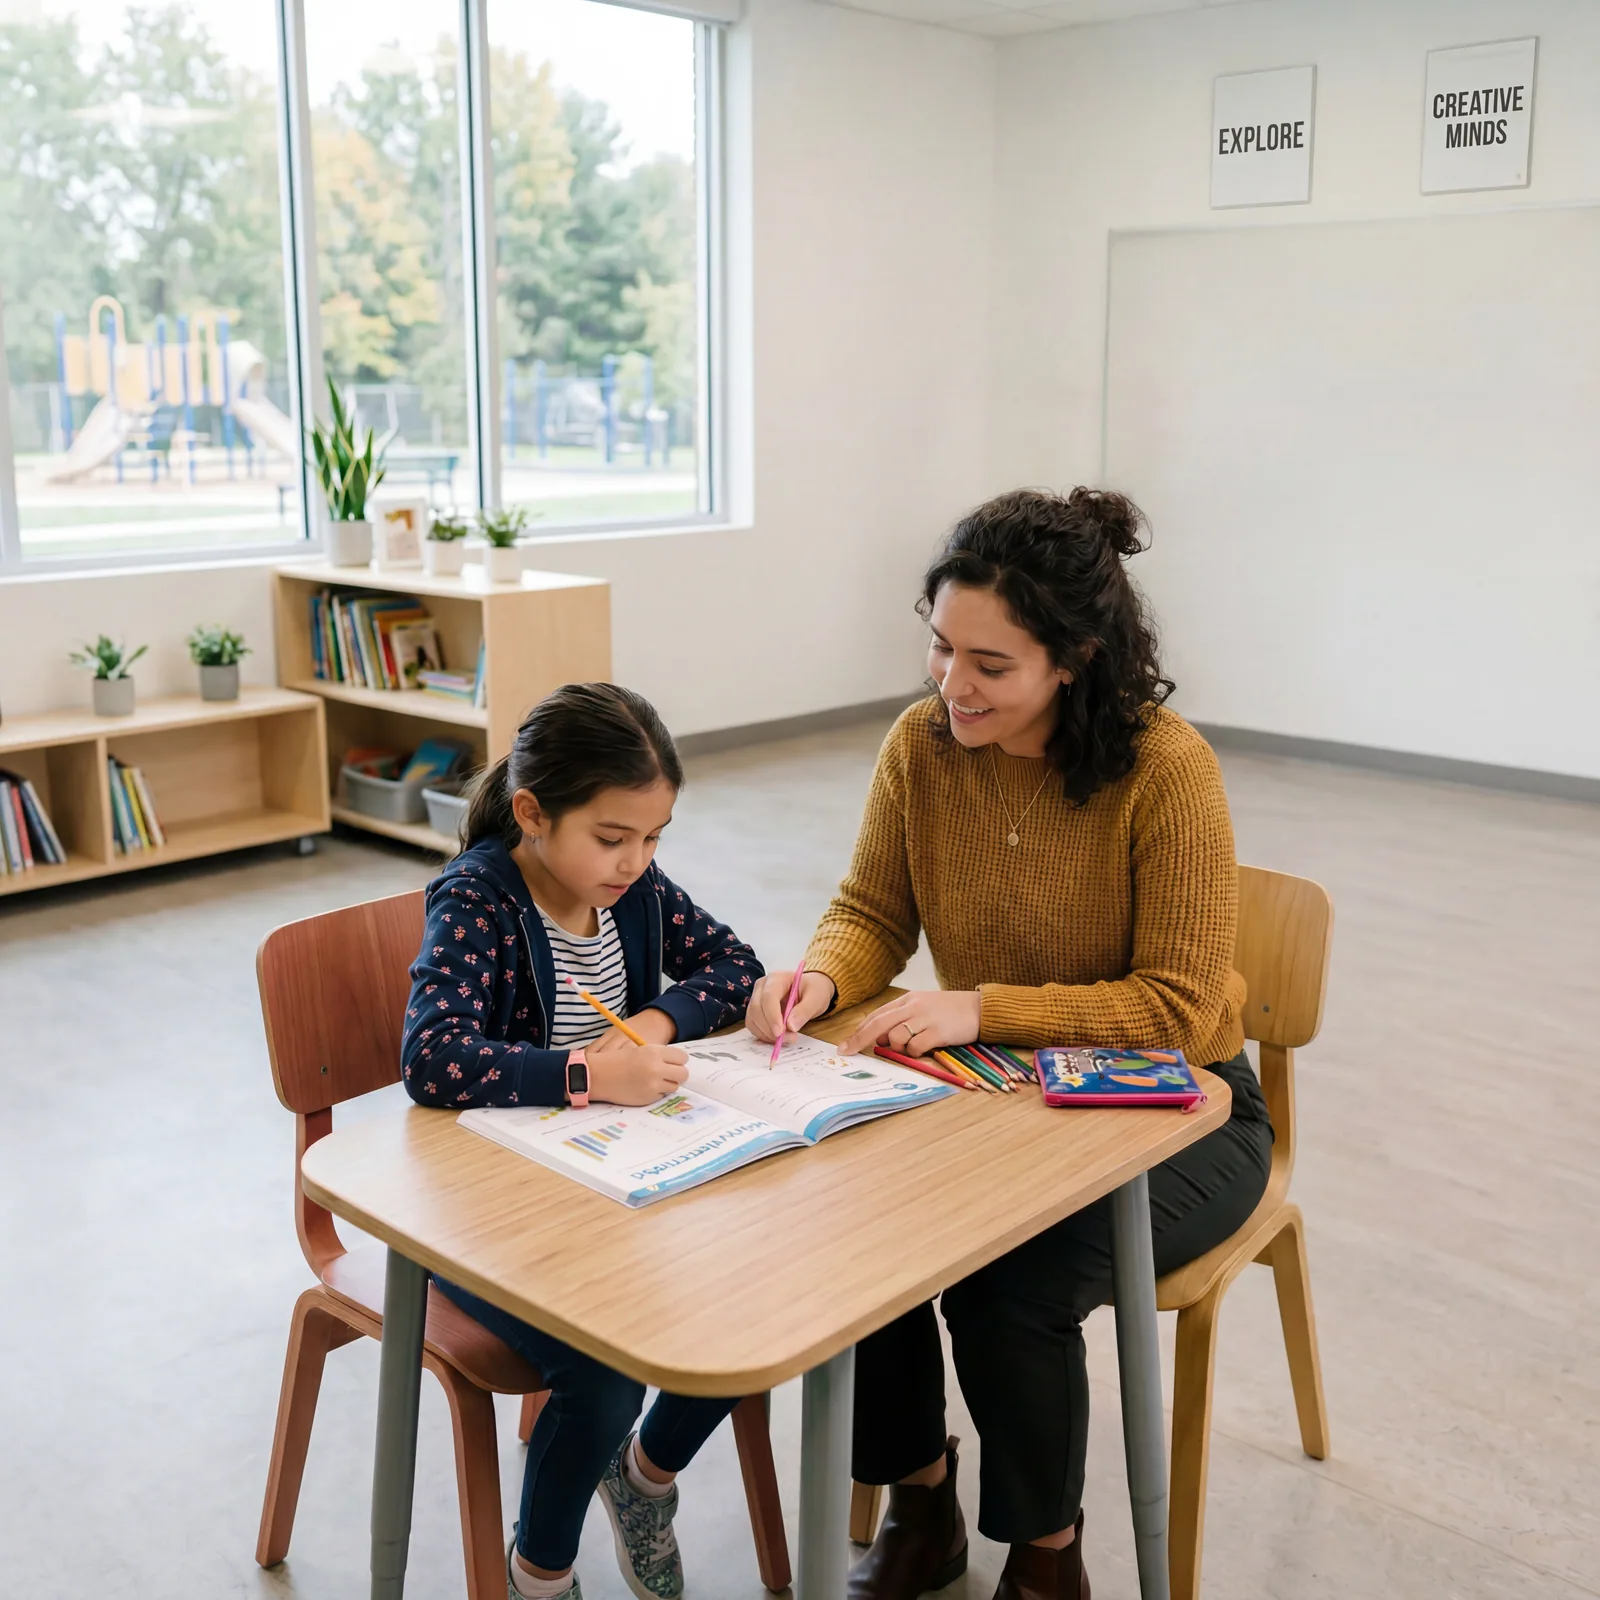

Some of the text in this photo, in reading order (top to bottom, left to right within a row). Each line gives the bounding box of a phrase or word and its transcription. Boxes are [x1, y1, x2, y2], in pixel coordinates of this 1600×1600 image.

[1432, 85, 1525, 119] CREATIVE
[1218, 120, 1305, 155] EXPLORE
[1445, 118, 1508, 149] MINDS
